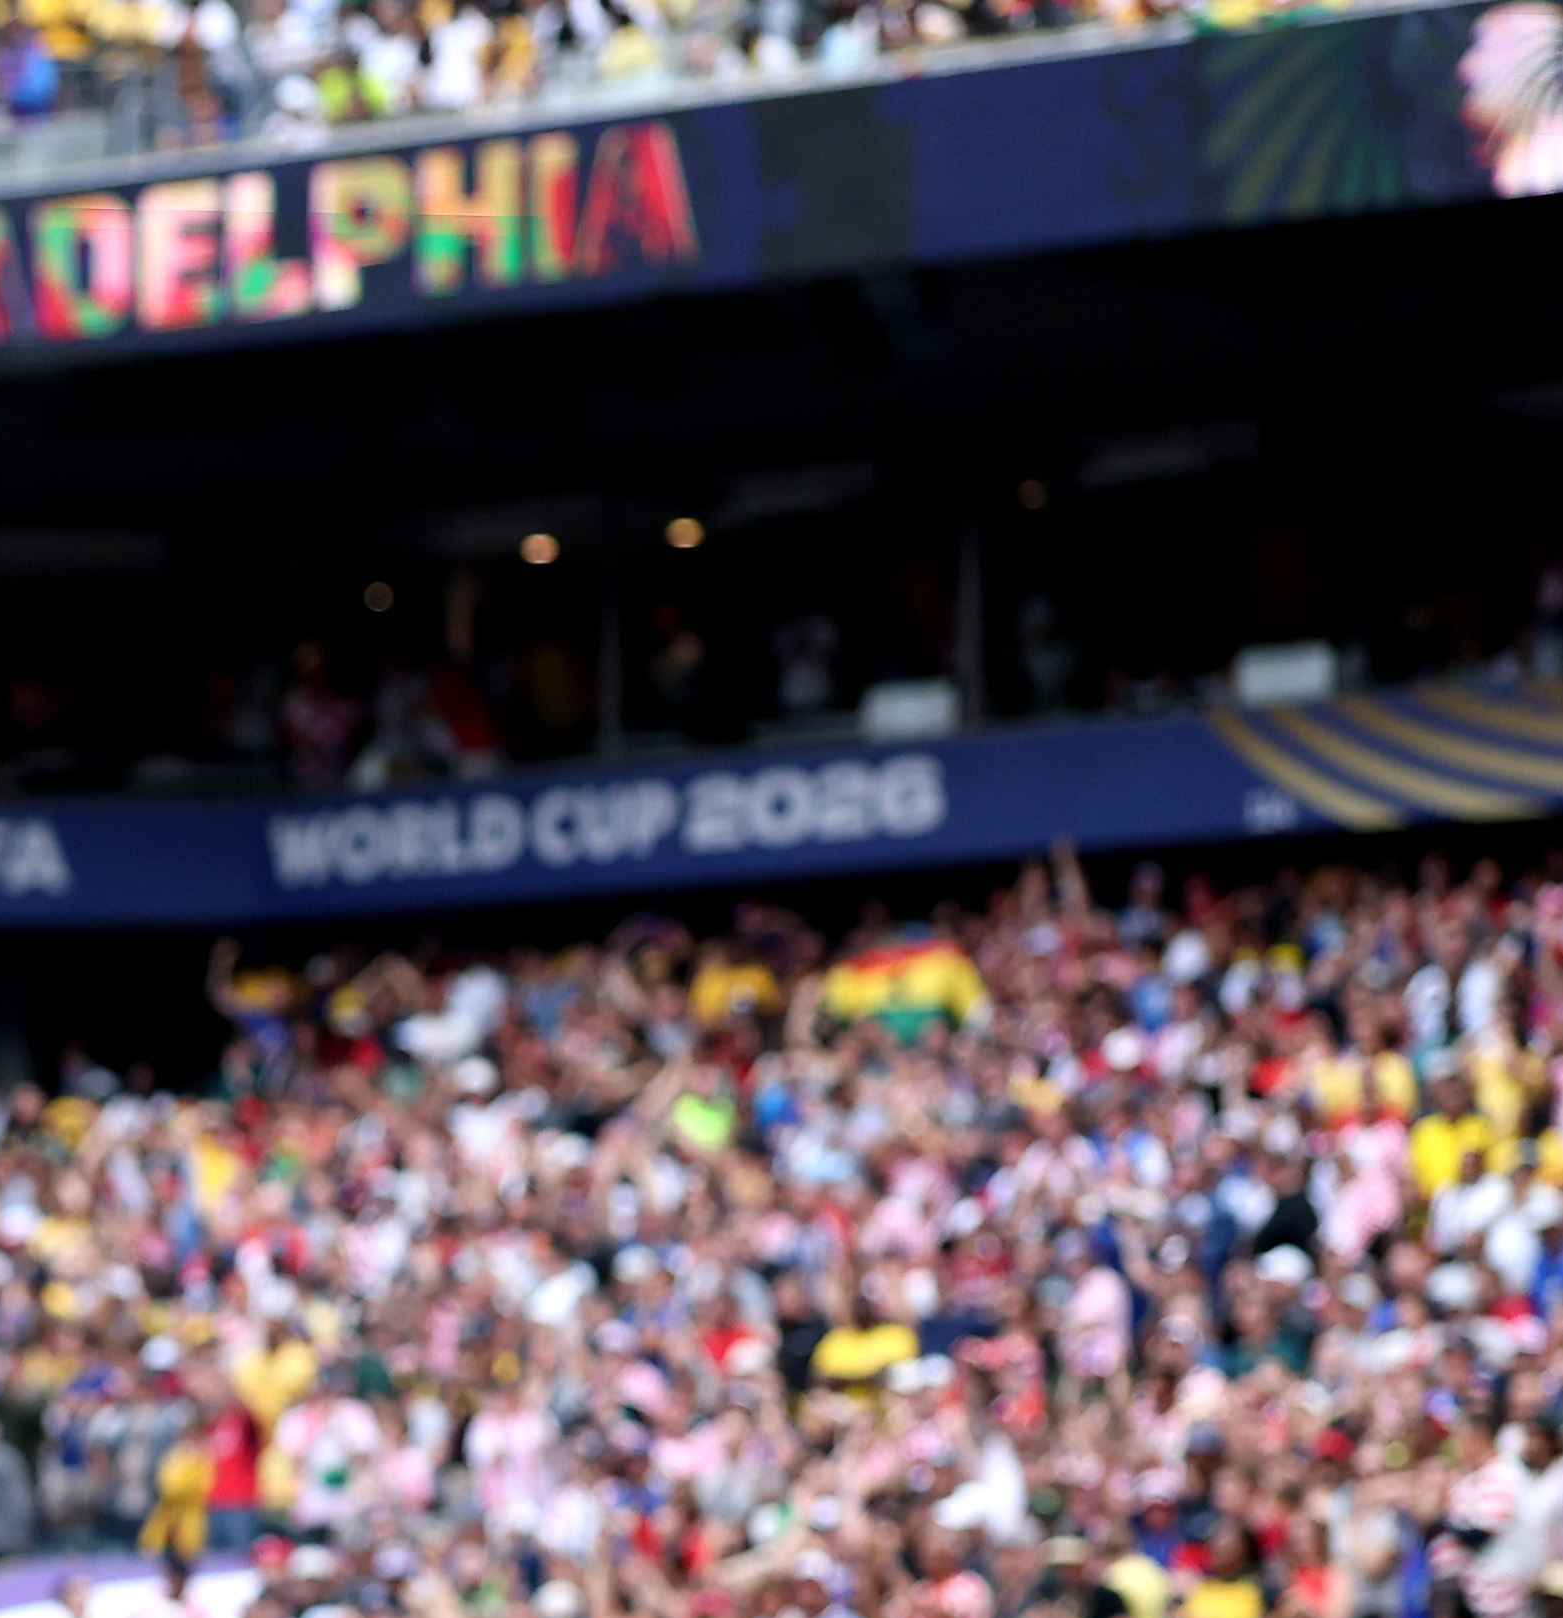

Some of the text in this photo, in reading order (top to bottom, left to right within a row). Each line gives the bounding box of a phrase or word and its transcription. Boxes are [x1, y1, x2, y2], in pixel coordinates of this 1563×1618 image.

[267, 793, 524, 890] WORLD
[530, 778, 675, 868] CUP
[681, 753, 948, 855] 2026
